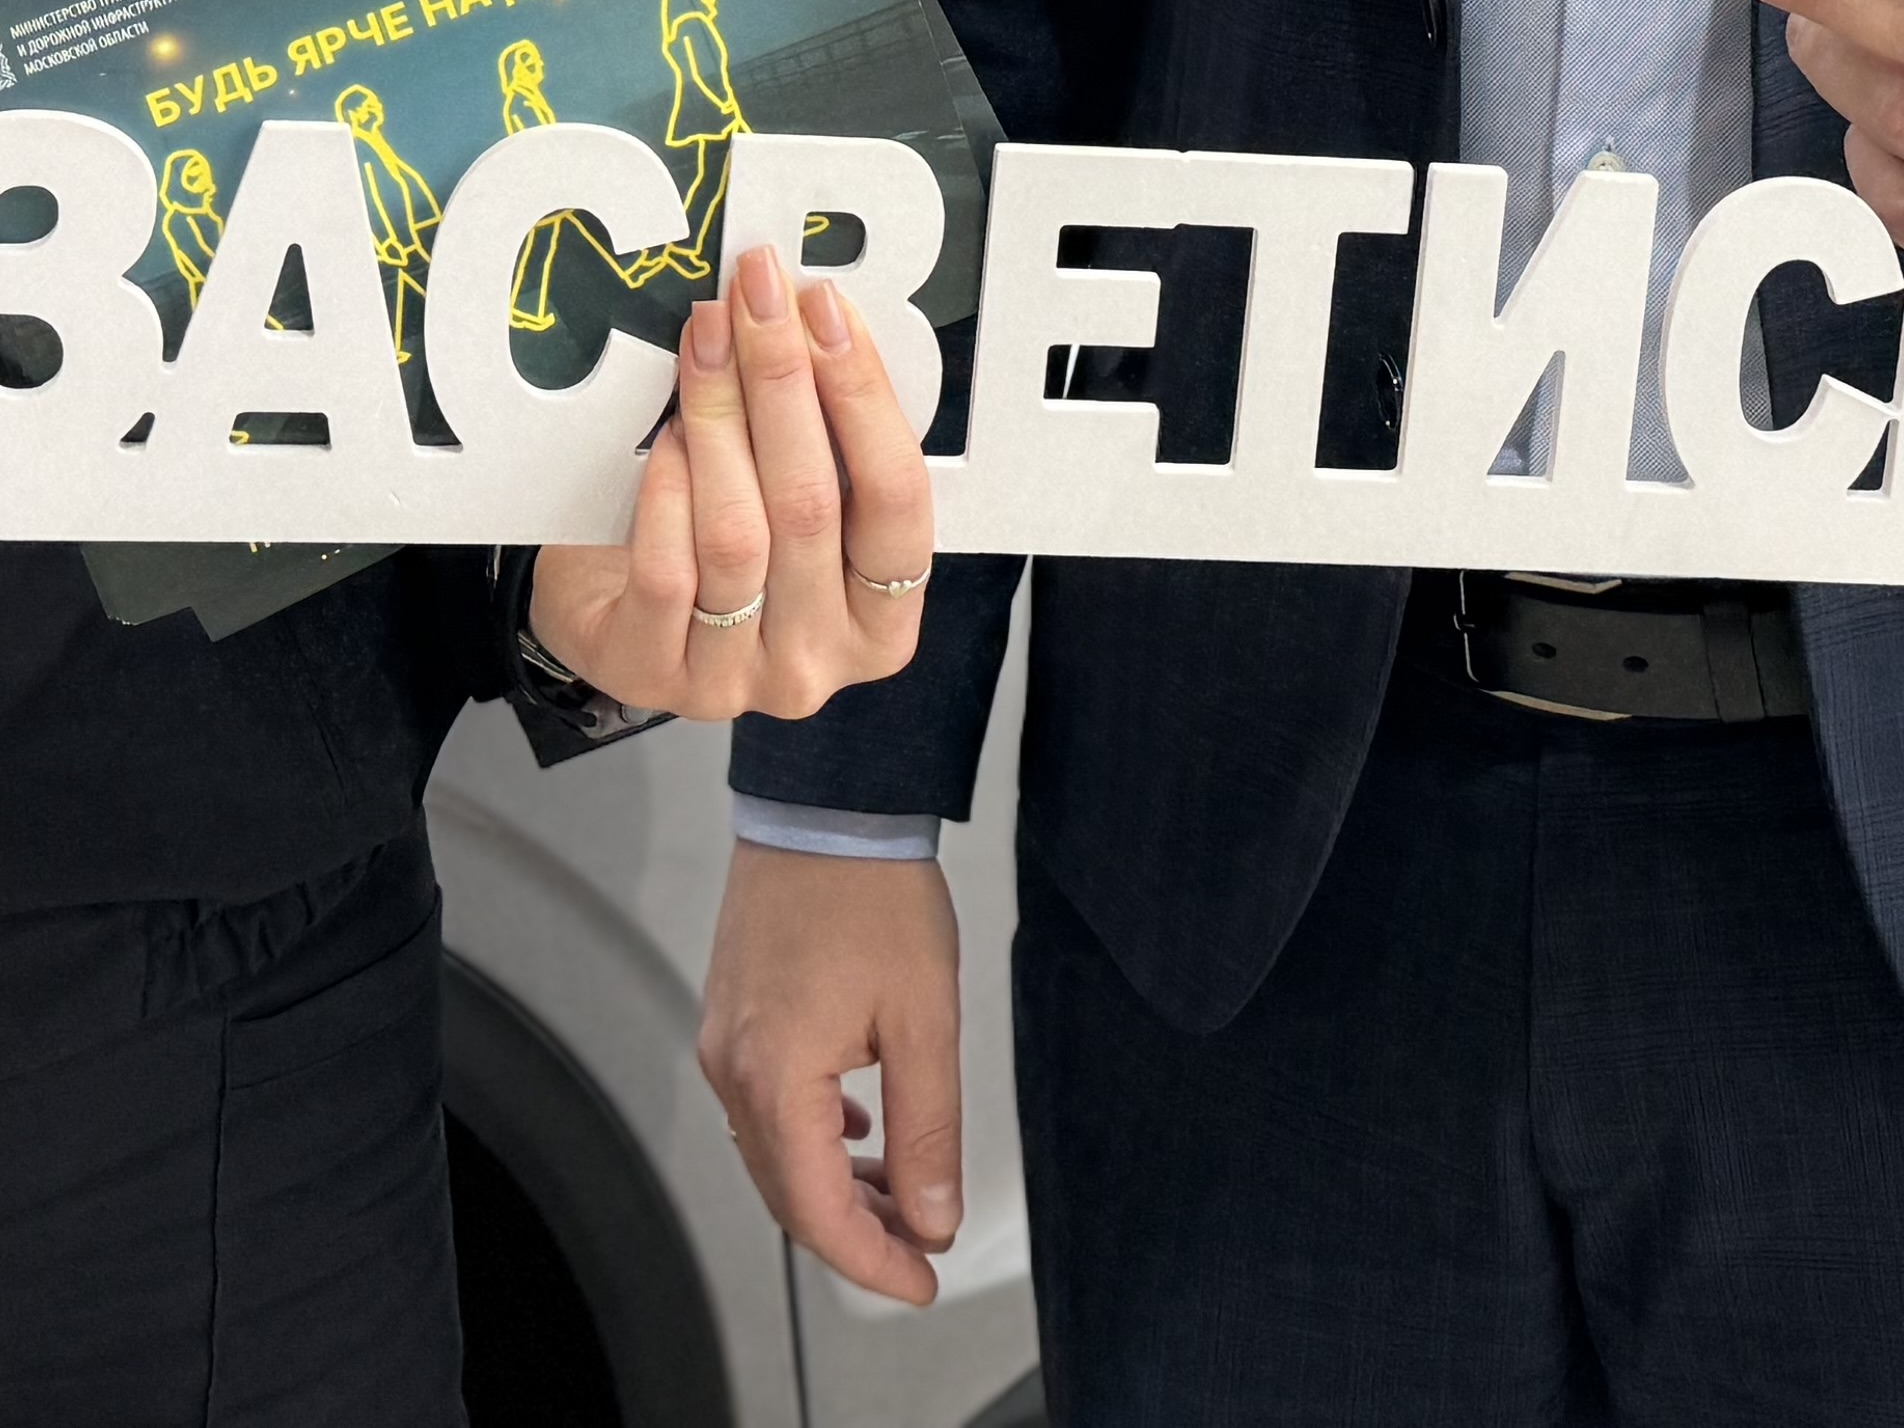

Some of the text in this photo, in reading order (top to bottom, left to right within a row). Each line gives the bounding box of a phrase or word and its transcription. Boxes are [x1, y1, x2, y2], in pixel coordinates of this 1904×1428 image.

[17, 44, 27, 57] И
[29, 20, 91, 56] ДОРОЖНОЙ
[24, 21, 150, 75] МОСКОВСКОЙ ОБЛАСТИ
[146, 58, 279, 127] БУДЬ
[288, 2, 413, 76] ЯРЧЕ
